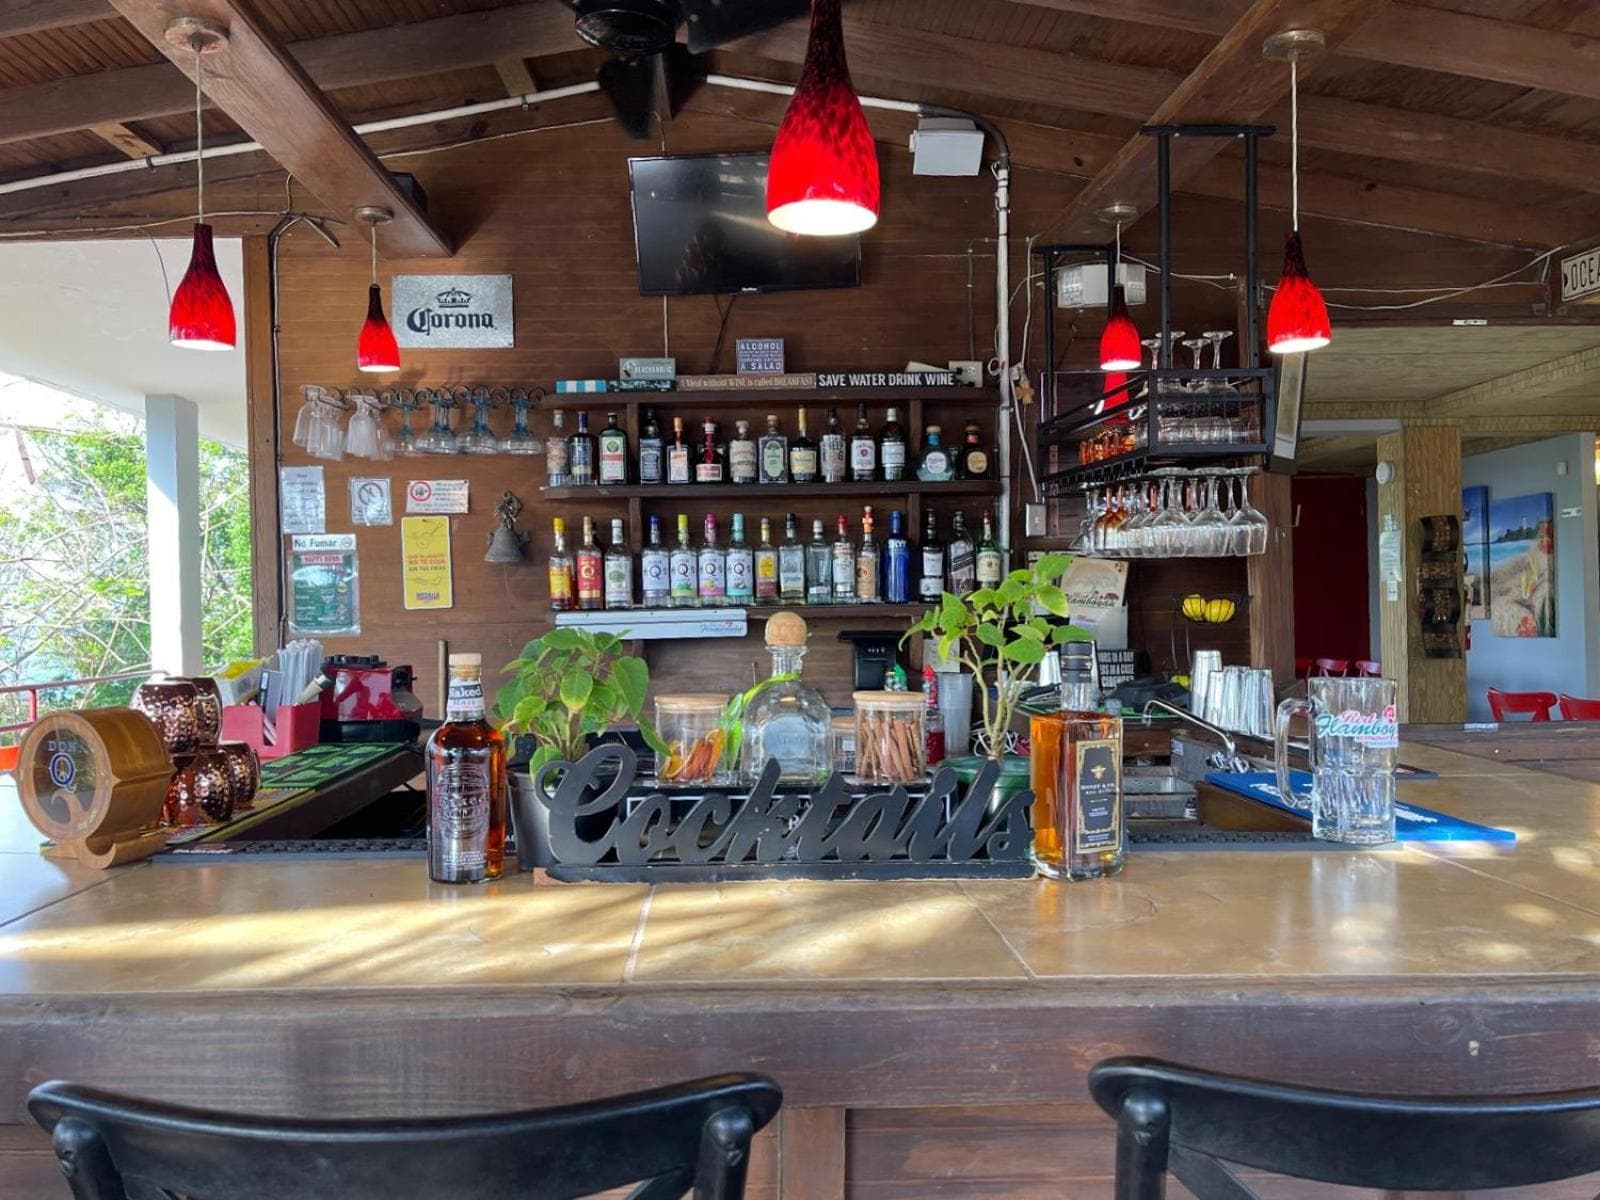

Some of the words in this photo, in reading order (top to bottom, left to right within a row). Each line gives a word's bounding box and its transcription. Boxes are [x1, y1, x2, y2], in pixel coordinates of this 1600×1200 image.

[406, 307, 494, 336] Corona
[741, 342, 782, 350] ALCOHOL
[751, 362, 781, 370] SALAD
[819, 373, 847, 387] SAVE
[848, 373, 886, 387] WATER
[888, 373, 922, 387] DRINK
[924, 372, 955, 386] WINE
[294, 539, 307, 548] No
[309, 538, 338, 548] Fumar
[649, 565, 661, 580] Q
[678, 563, 689, 578] Q
[704, 562, 717, 577] Q
[733, 562, 745, 577] Q
[449, 685, 482, 699] Naked
[1342, 711, 1376, 723] Red
[49, 752, 77, 794] Q
[535, 743, 1035, 864] Cocktails
